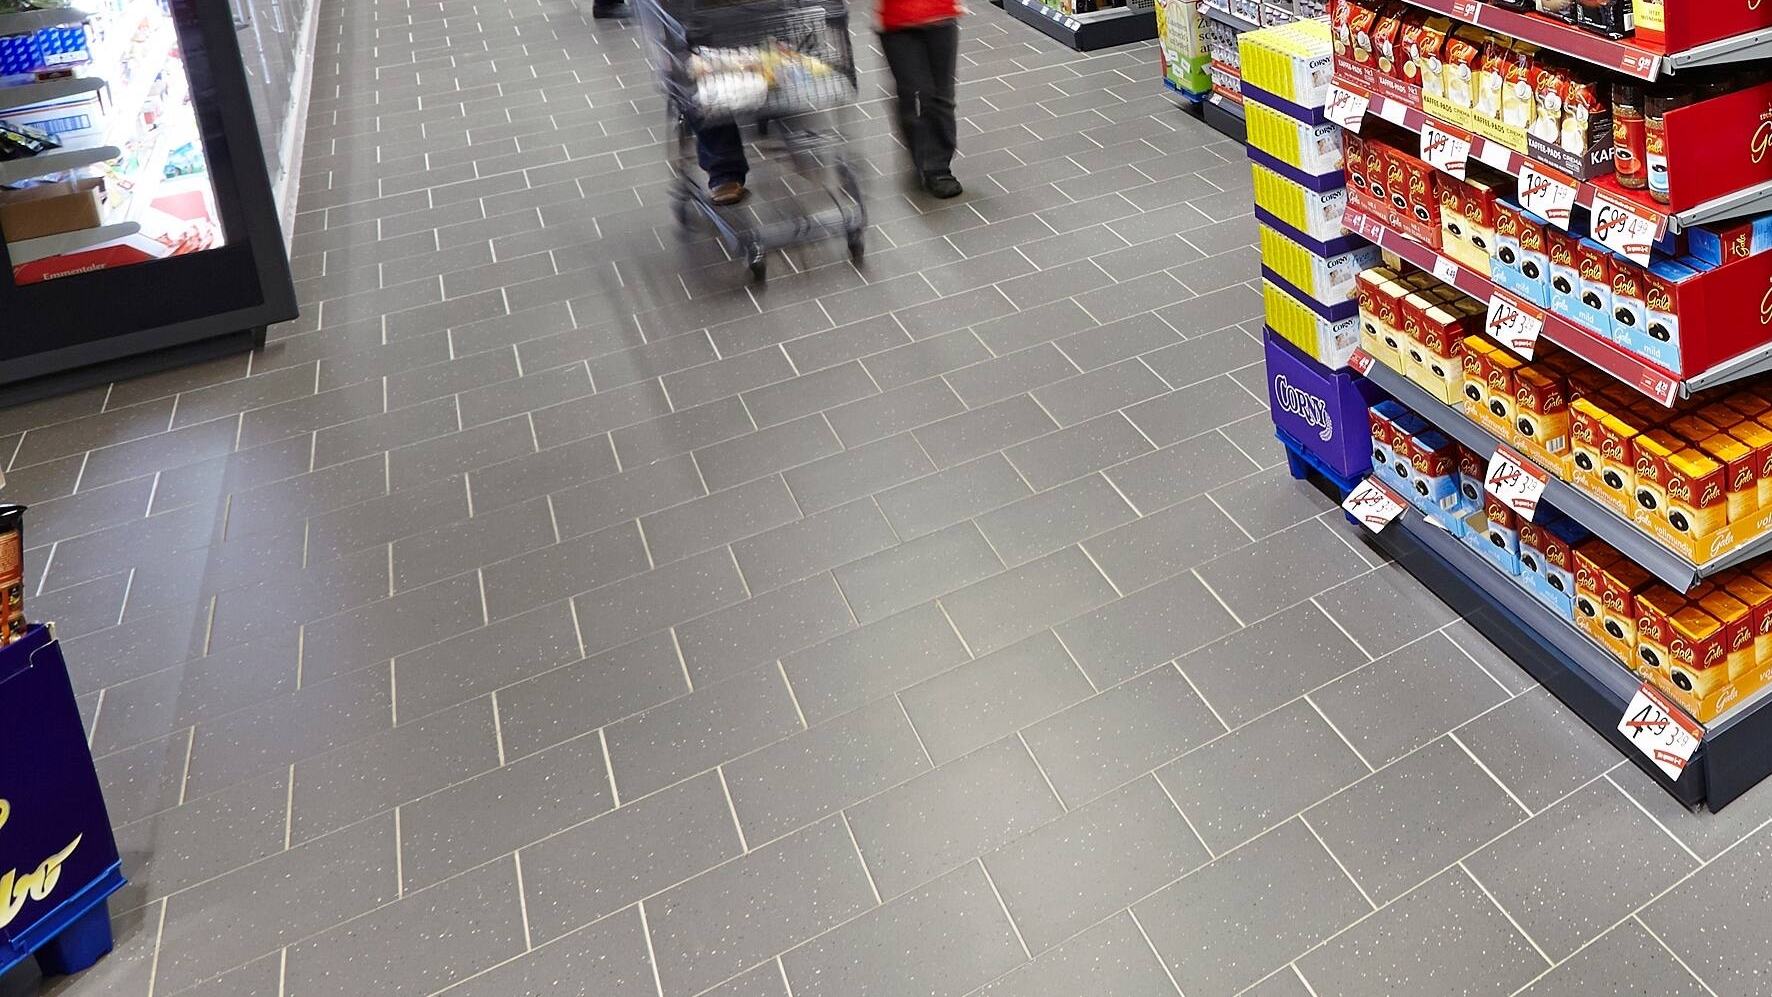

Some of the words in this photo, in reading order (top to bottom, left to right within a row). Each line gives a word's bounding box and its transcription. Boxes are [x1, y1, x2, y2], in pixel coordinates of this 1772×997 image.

[1309, 56, 1332, 70] CORNY
[1314, 124, 1336, 137] CORNY
[1591, 150, 1614, 165] KAF
[1320, 190, 1343, 204] CORNY
[1496, 215, 1517, 236] Gala
[1520, 229, 1541, 251] Gala
[1327, 256, 1348, 269] CORNY
[1551, 243, 1571, 266] Gala
[1580, 258, 1602, 280] Gala
[1613, 273, 1636, 296] Gala
[1647, 288, 1671, 311] Gala
[1332, 319, 1354, 333] CORNY
[1578, 310, 1594, 324] mild
[1643, 343, 1661, 358] mild
[1463, 356, 1481, 375] Gala
[1488, 370, 1506, 391] Gala
[1517, 388, 1536, 410] Gala
[1572, 422, 1593, 444] Gala
[1601, 439, 1623, 463] Gala
[1636, 459, 1658, 482] Gala
[1667, 477, 1690, 503] Gala
[1734, 471, 1753, 492] Gala
[1700, 488, 1722, 508] Gala
[1489, 504, 1507, 525] Gala
[1546, 544, 1565, 565] Gala
[1710, 531, 1734, 557] Gala
[1576, 569, 1596, 592] Gala
[1602, 591, 1623, 613] Gala
[1639, 617, 1660, 640] Gala
[1733, 631, 1751, 650] Gala
[1670, 639, 1694, 664] Gala
[1704, 647, 1724, 668] Gala
[1715, 688, 1738, 713] Gala
